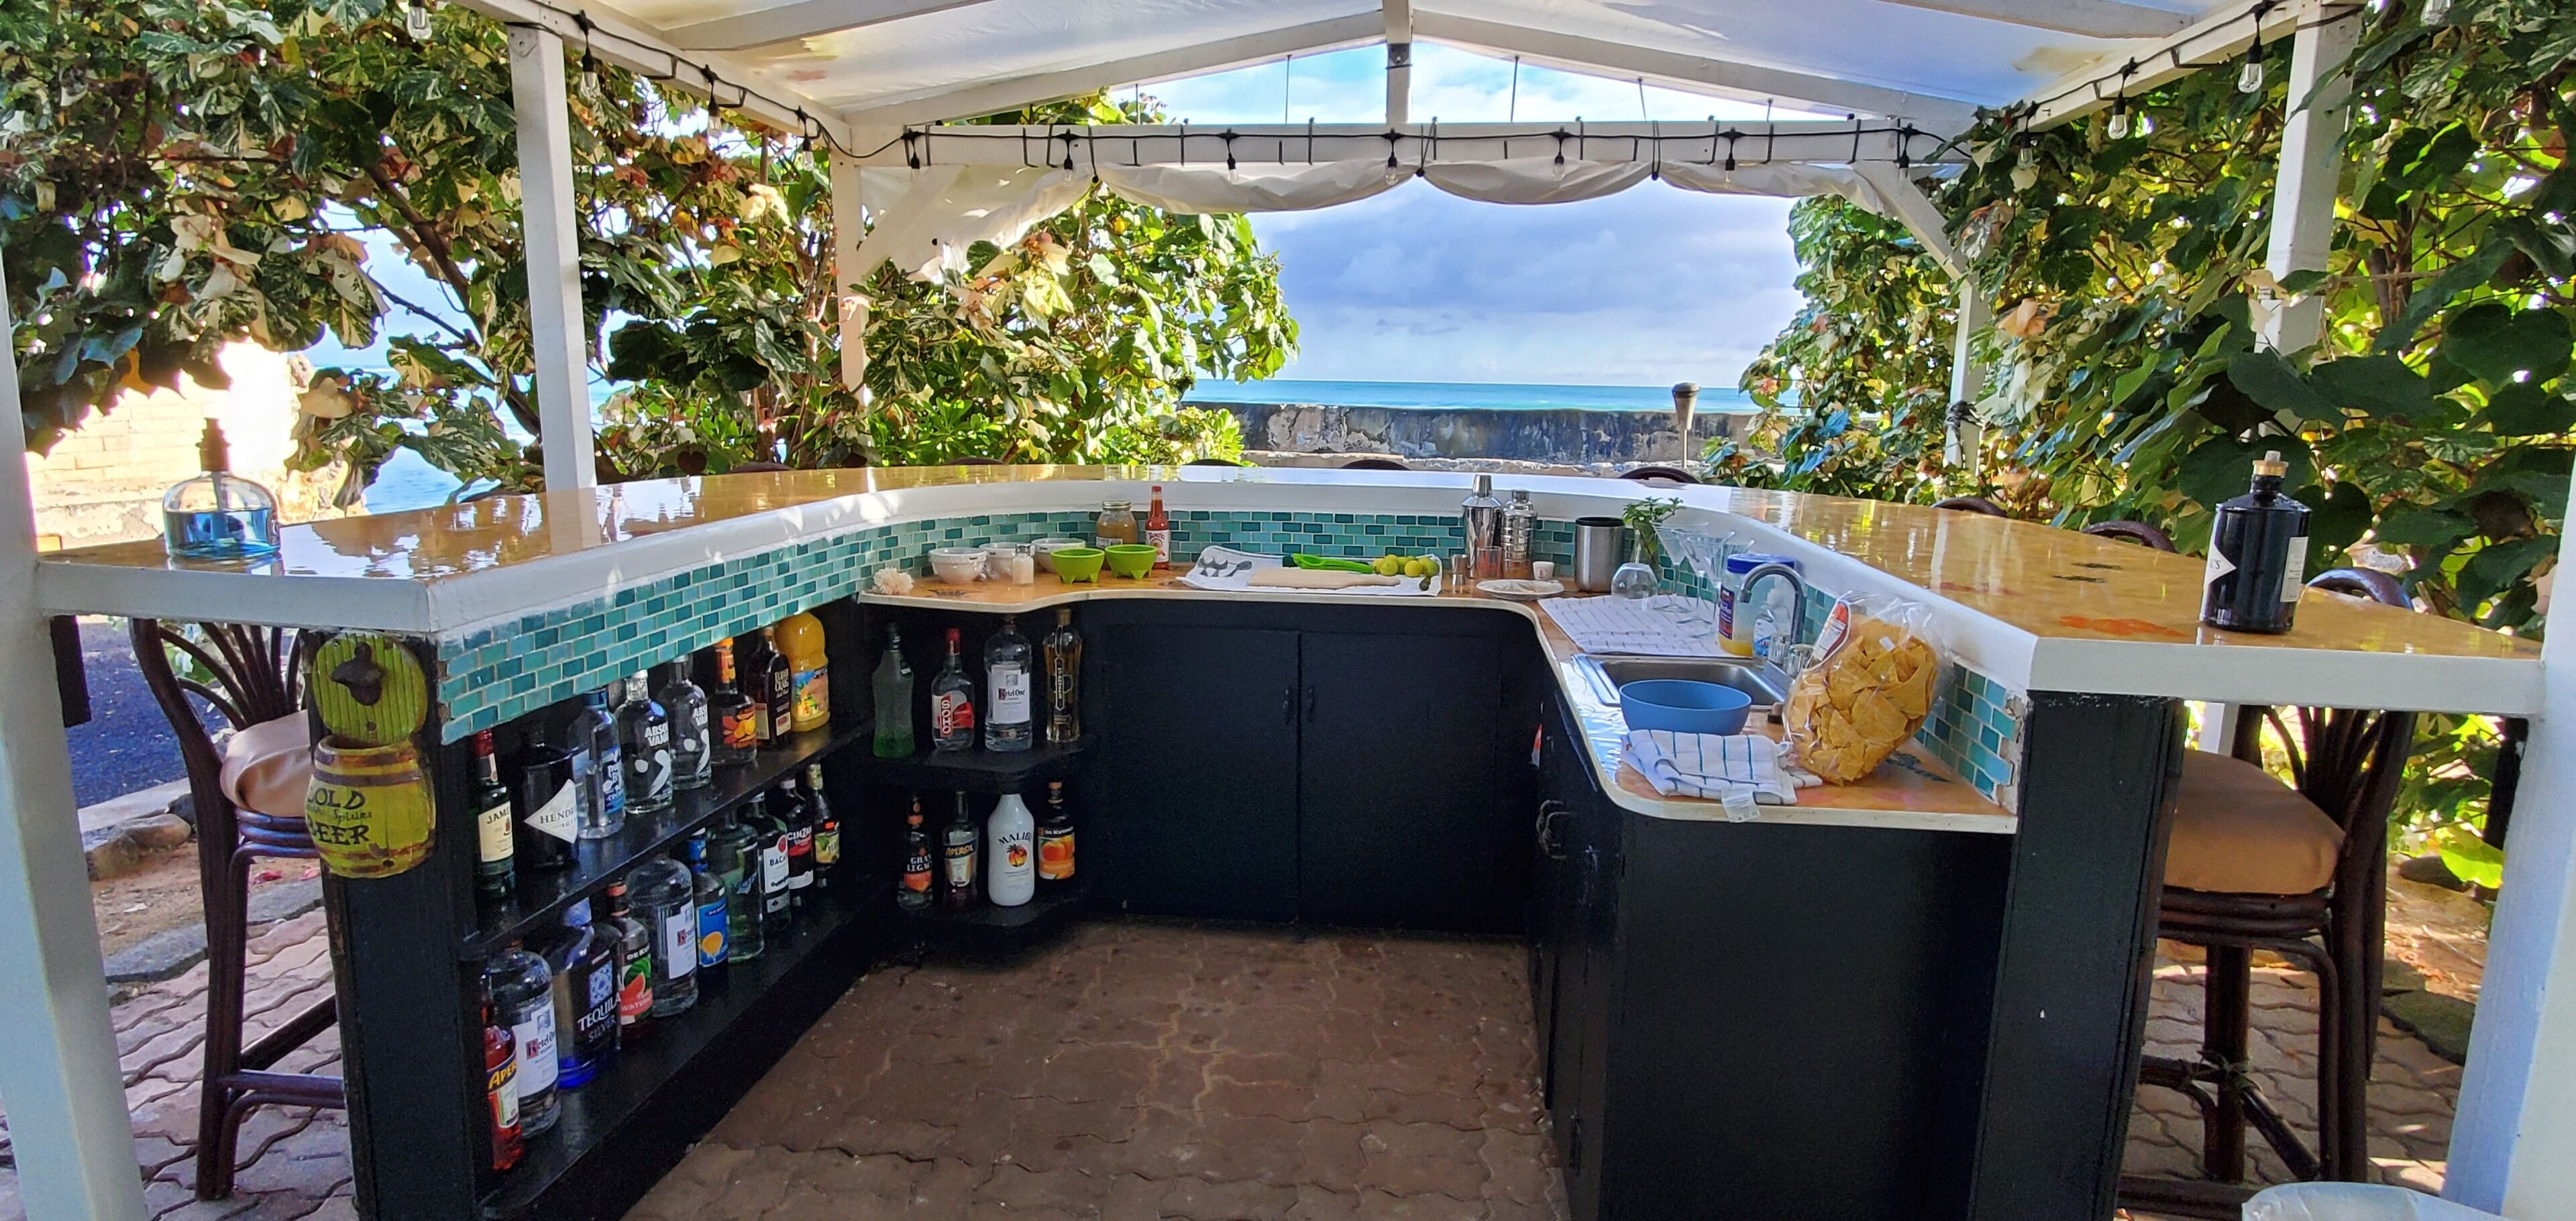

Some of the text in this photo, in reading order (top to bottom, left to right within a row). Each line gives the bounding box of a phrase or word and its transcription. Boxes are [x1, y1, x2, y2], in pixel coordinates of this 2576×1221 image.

[941, 700, 951, 734] SOHO
[307, 813, 370, 845] BEER
[578, 992, 621, 1032] TEQUILA
[588, 1014, 616, 1042] SILVER
